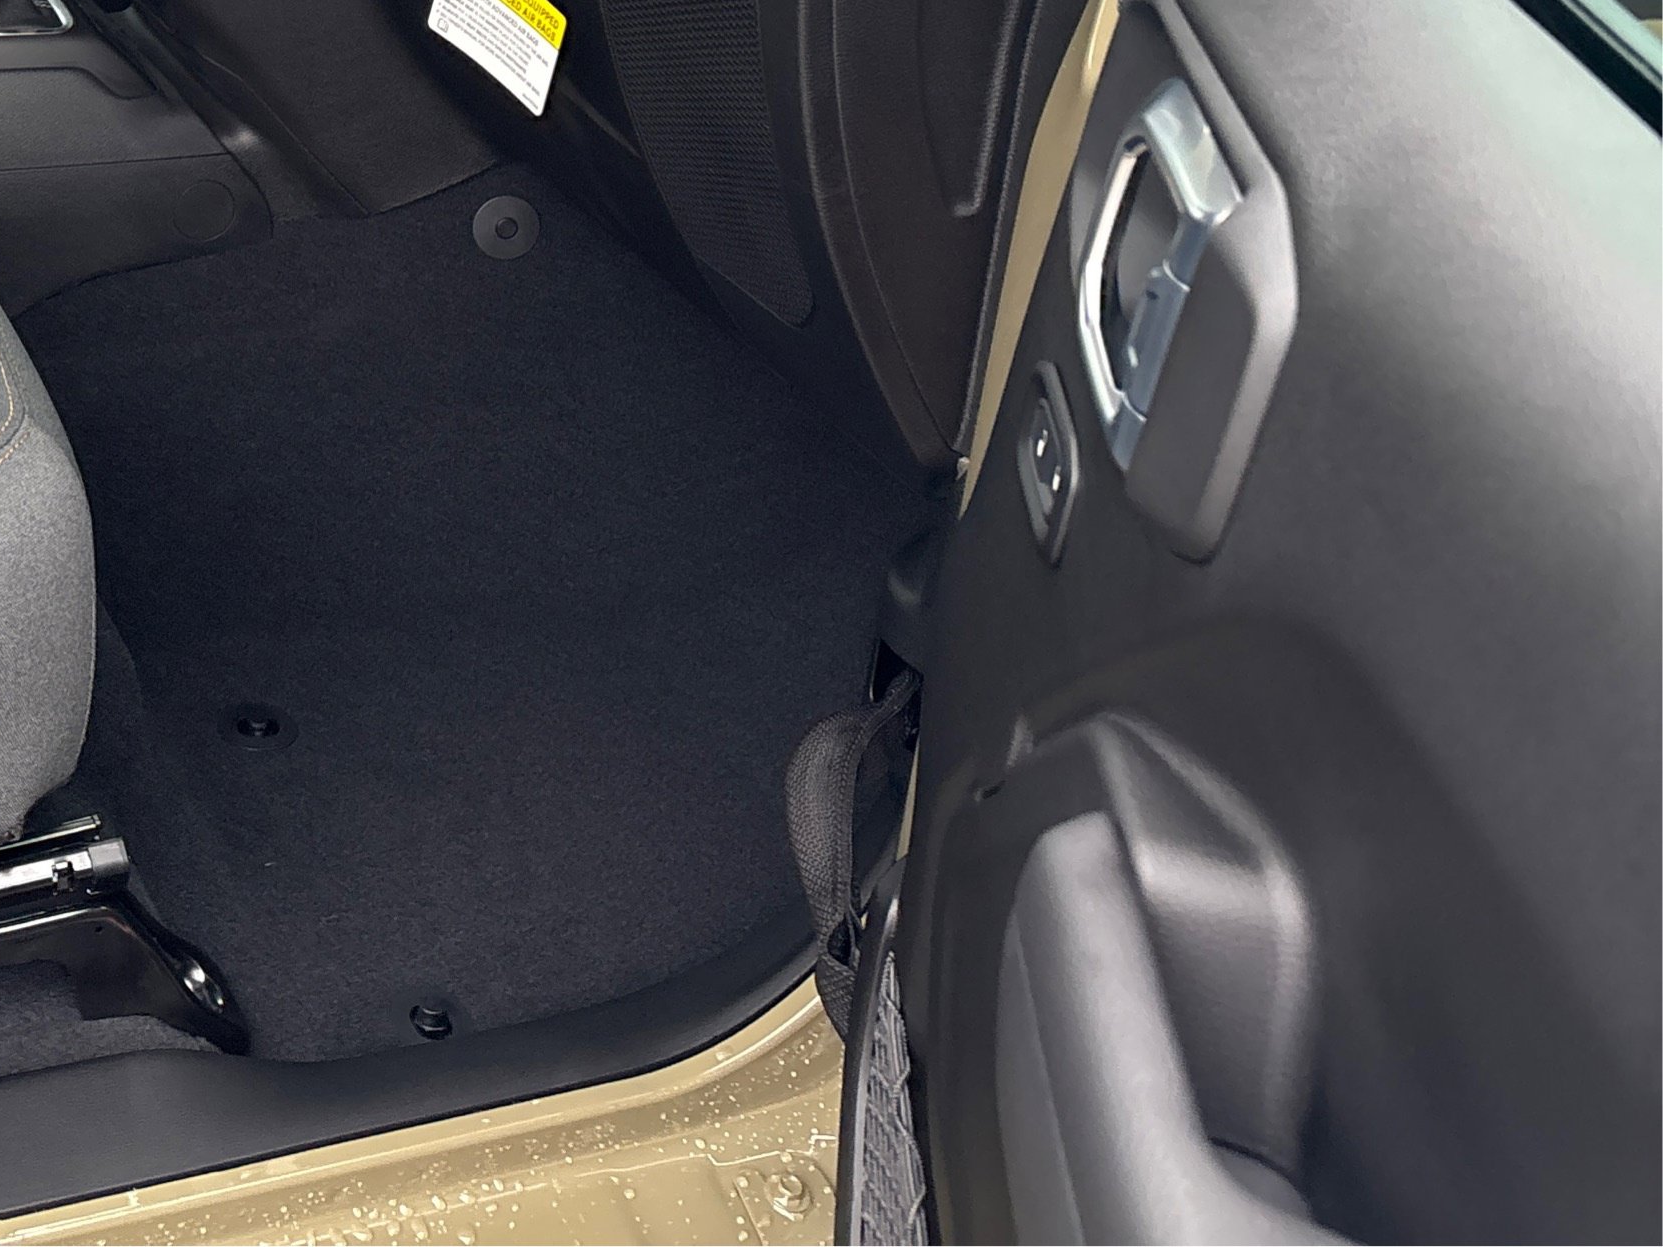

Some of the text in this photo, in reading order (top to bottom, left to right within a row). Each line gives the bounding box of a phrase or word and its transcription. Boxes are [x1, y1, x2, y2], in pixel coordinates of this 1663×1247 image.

[492, 4, 518, 28] ADVANCED
[522, 8, 535, 23] AIR
[536, 19, 556, 41] BAGS
